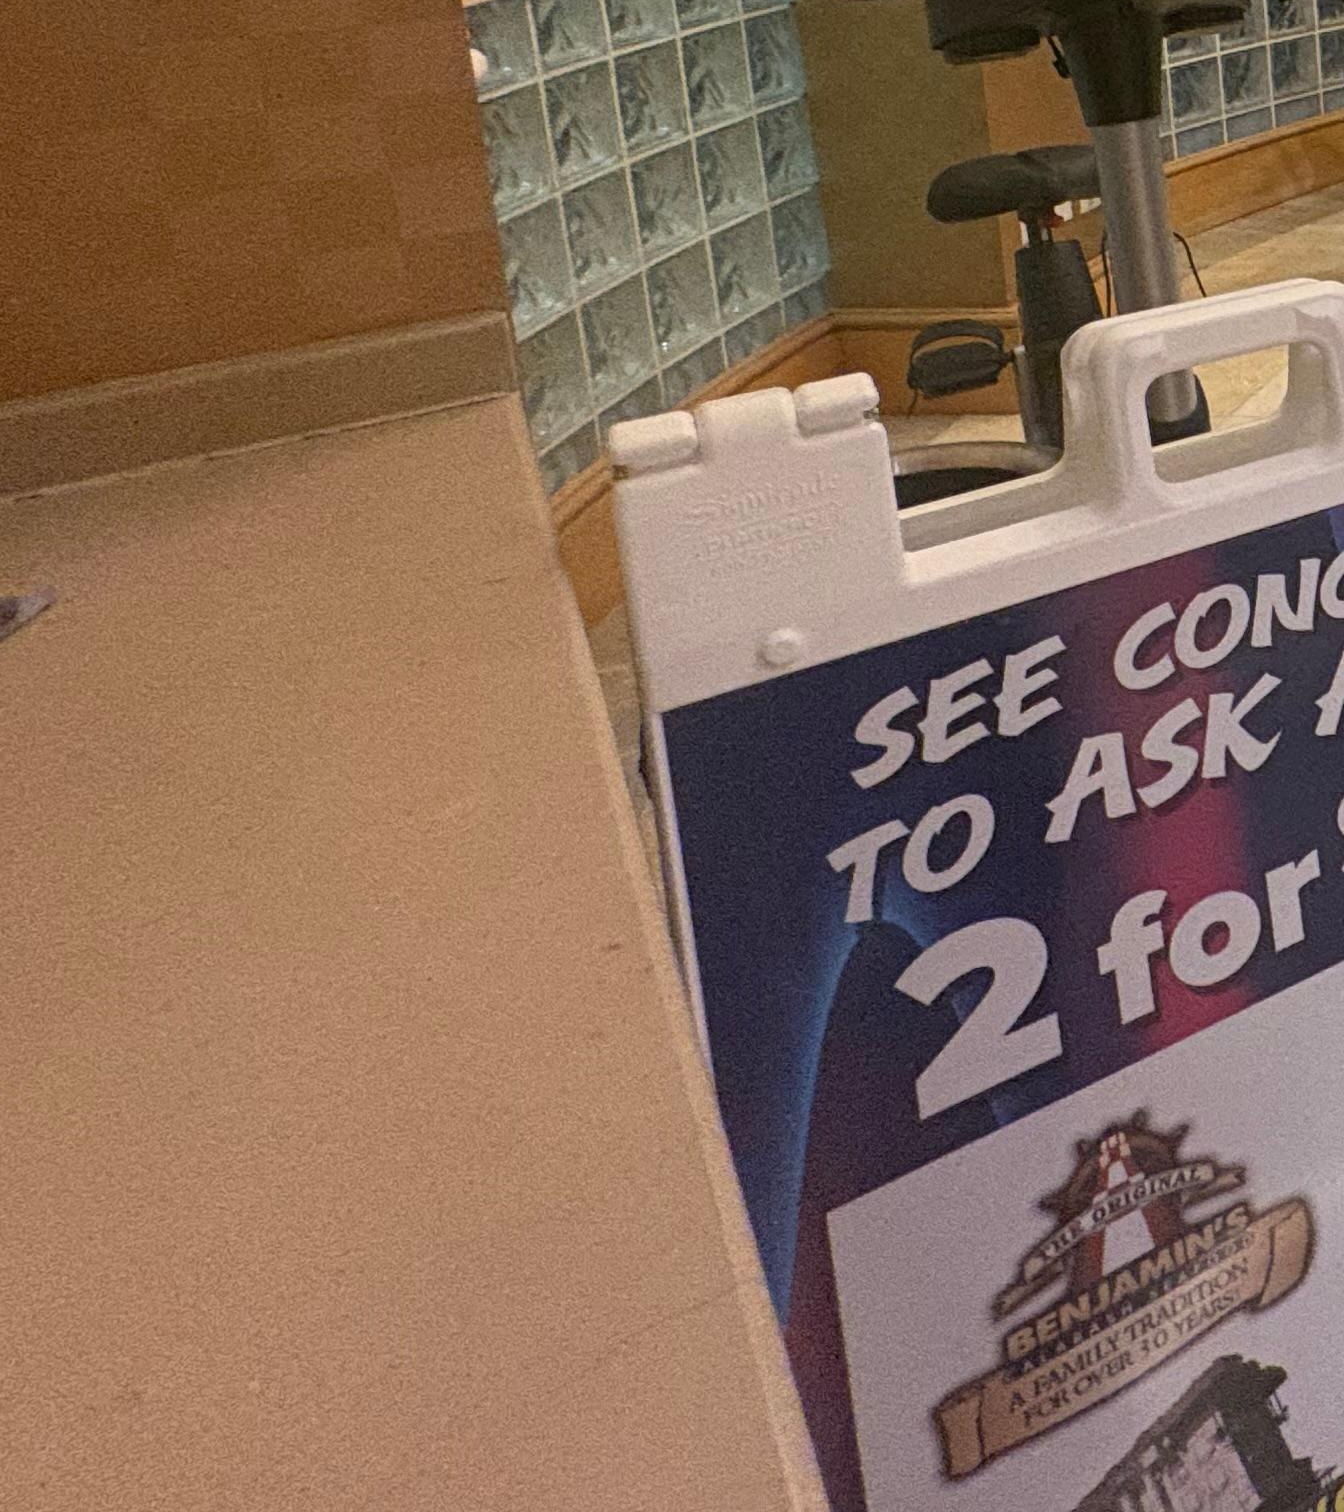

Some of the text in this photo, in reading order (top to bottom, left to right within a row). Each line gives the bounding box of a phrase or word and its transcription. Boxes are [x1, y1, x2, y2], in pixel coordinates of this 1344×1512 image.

[850, 634, 1067, 789] SEE
[825, 793, 996, 923] TO
[1044, 672, 1283, 844] ASK
[894, 916, 1063, 1121] 2
[1096, 848, 1321, 1026] for
[1092, 1165, 1204, 1224] ORIGINAL
[1007, 1205, 1250, 1359] BENJAMIN'S
[1008, 1258, 1251, 1414] A FAMILY TRADITION
[1022, 1385, 1072, 1427] FOR
[1071, 1351, 1136, 1402] OVER
[1140, 1325, 1170, 1358] 30
